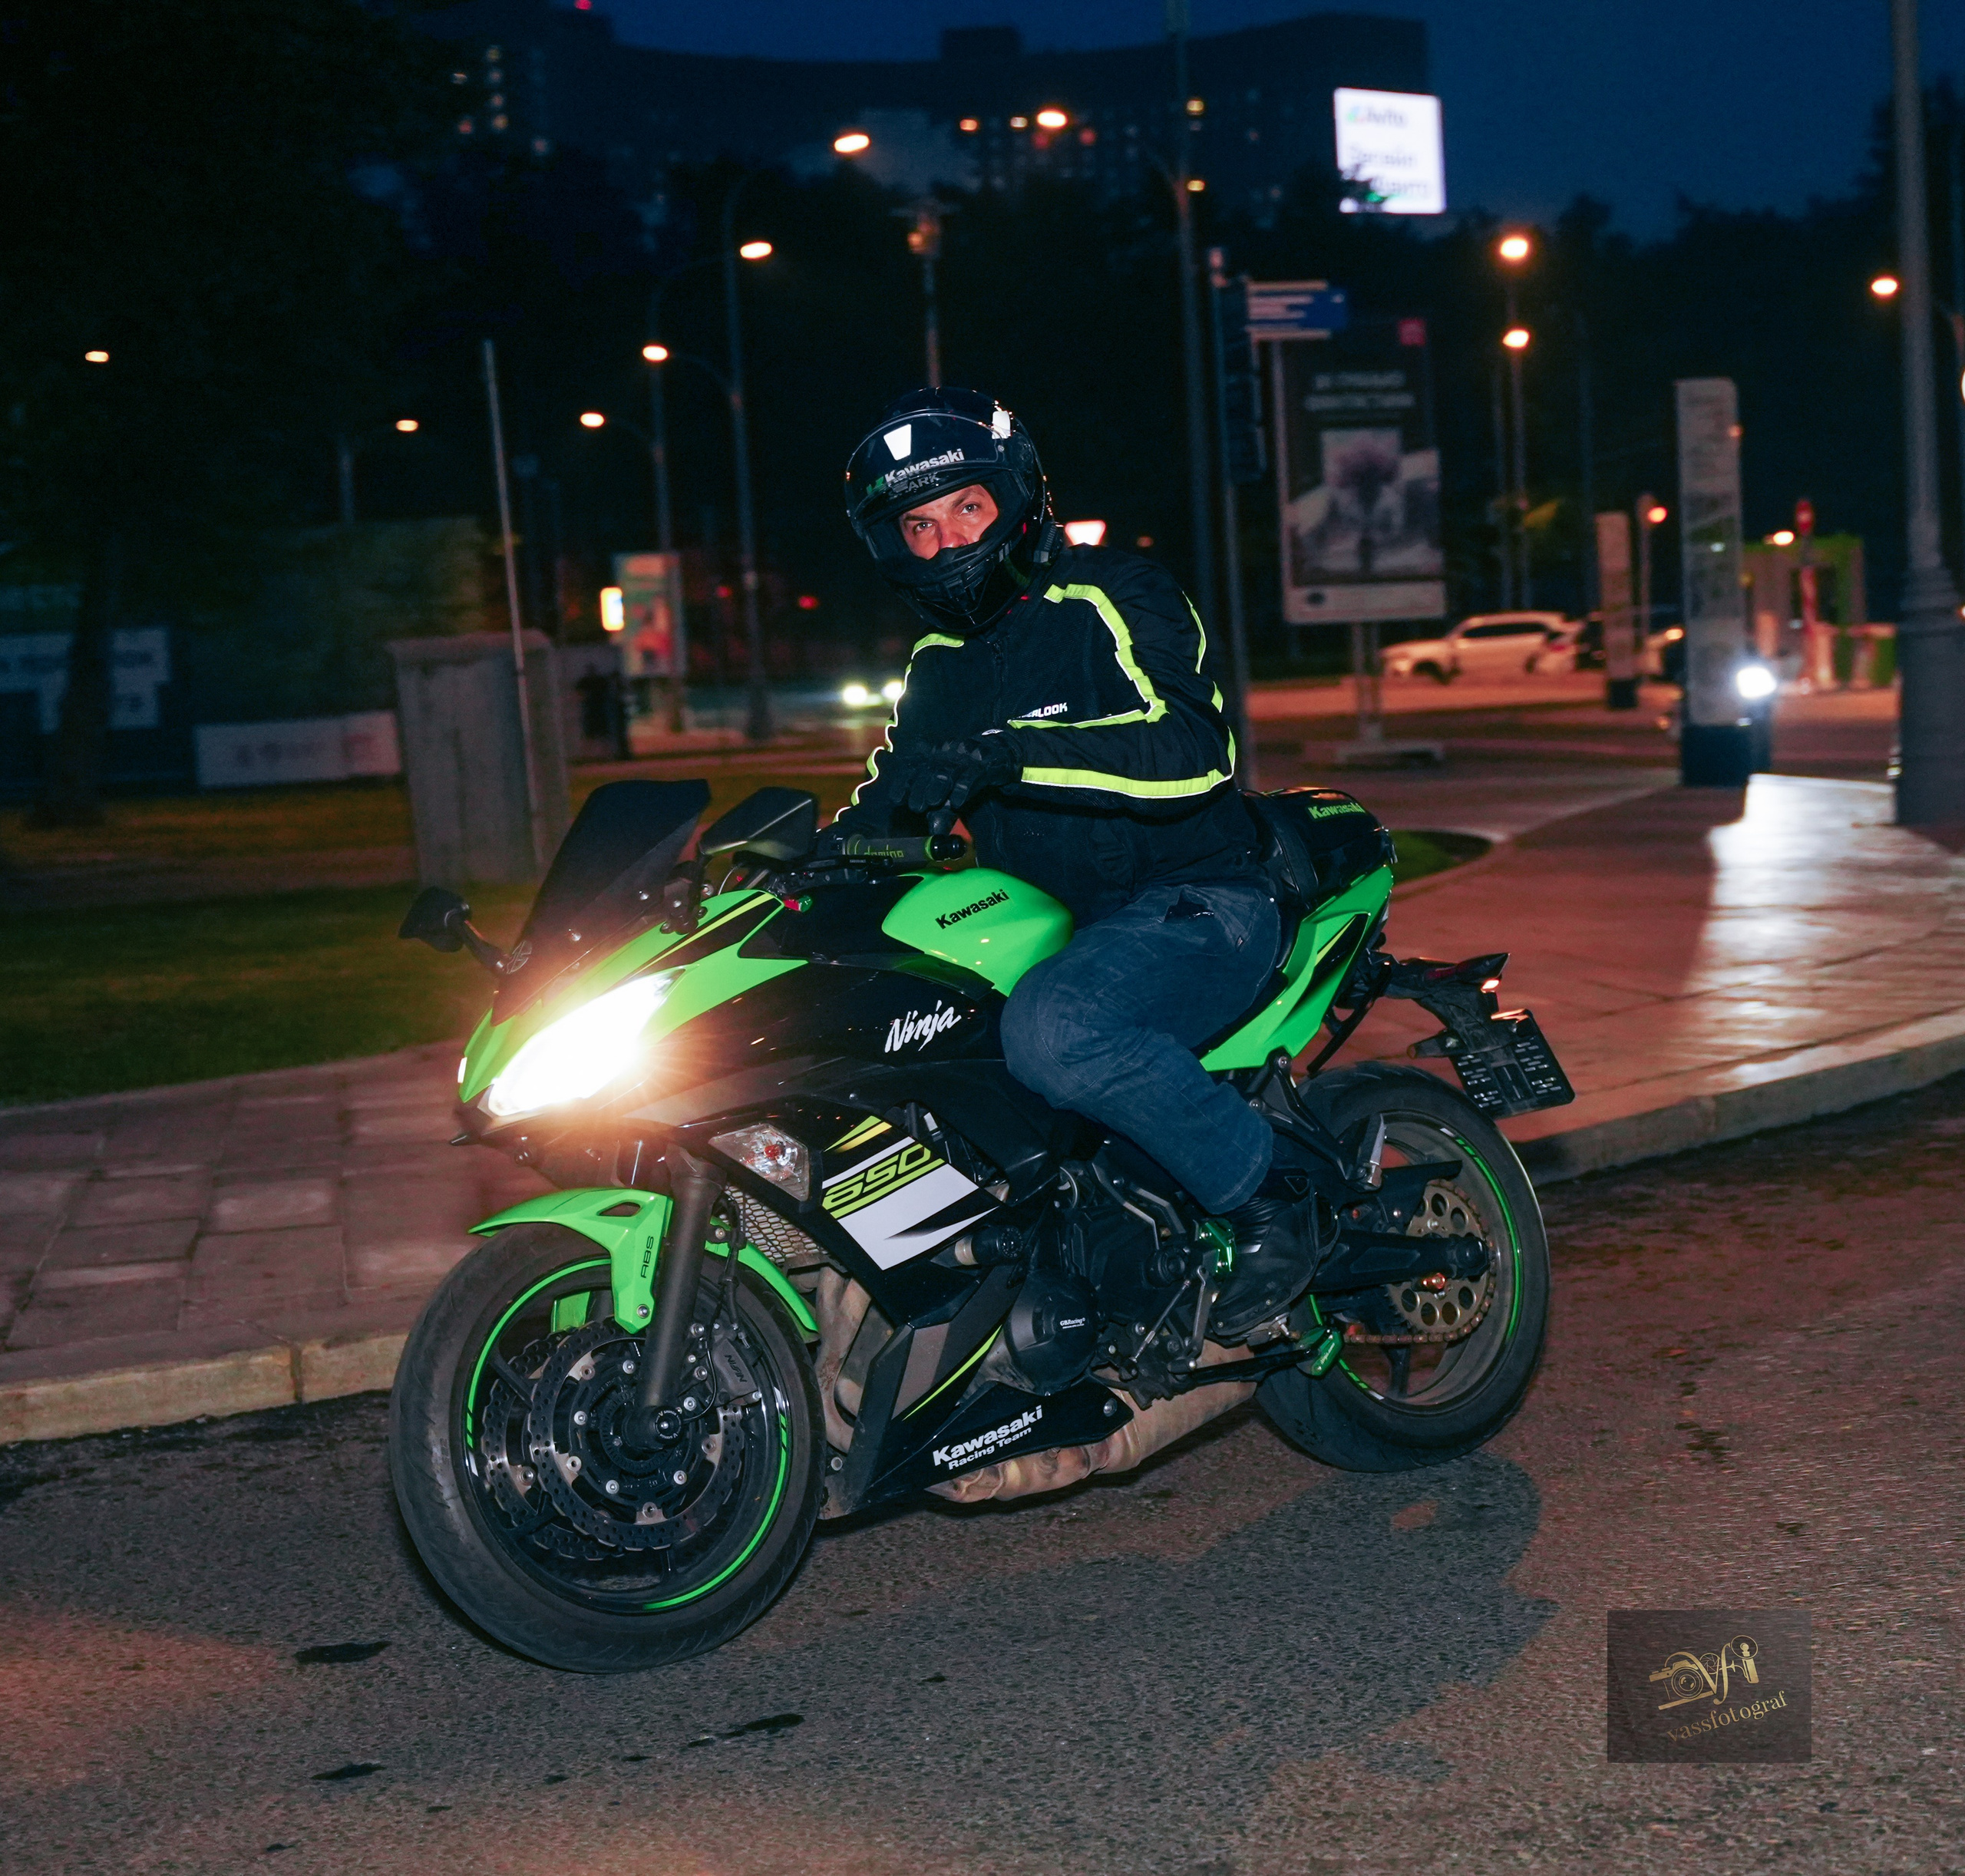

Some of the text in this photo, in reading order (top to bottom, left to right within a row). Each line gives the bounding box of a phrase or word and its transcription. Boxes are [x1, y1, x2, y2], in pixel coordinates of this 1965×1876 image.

[884, 448, 965, 484] Kawasaki
[935, 889, 1010, 930] Kawasaki
[885, 1000, 962, 1053] Ninja
[822, 1144, 931, 1210] 650
[640, 1235, 654, 1279] ABS
[932, 1405, 1043, 1466] Kawasaki
[948, 1427, 1032, 1471] Racing Team
